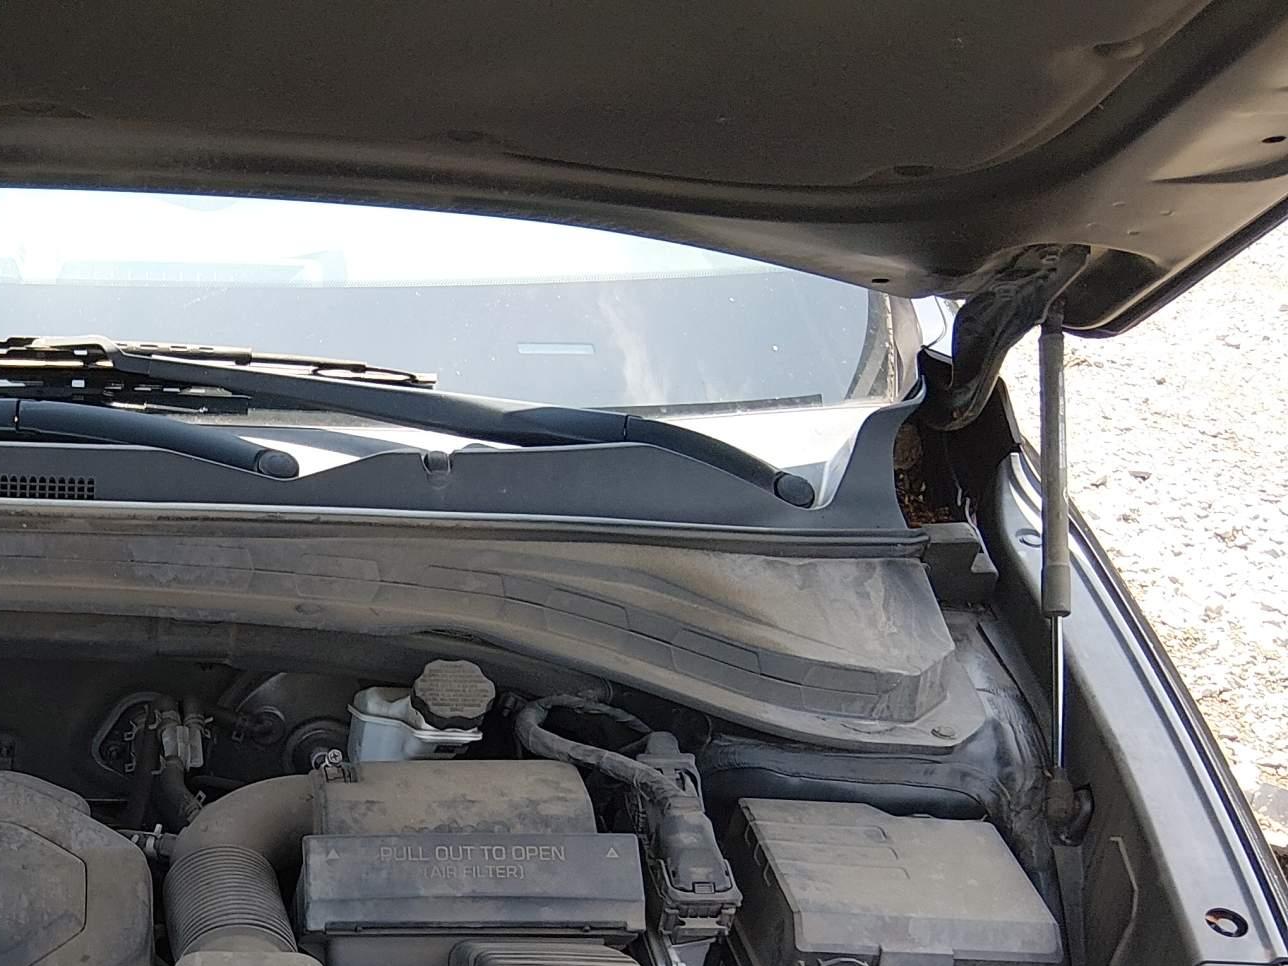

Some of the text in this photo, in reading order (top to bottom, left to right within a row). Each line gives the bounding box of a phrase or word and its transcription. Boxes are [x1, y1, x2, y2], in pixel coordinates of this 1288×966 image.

[379, 846, 566, 861] PULL OUT TO OPEN
[423, 865, 525, 880] (AIR FILTER)
